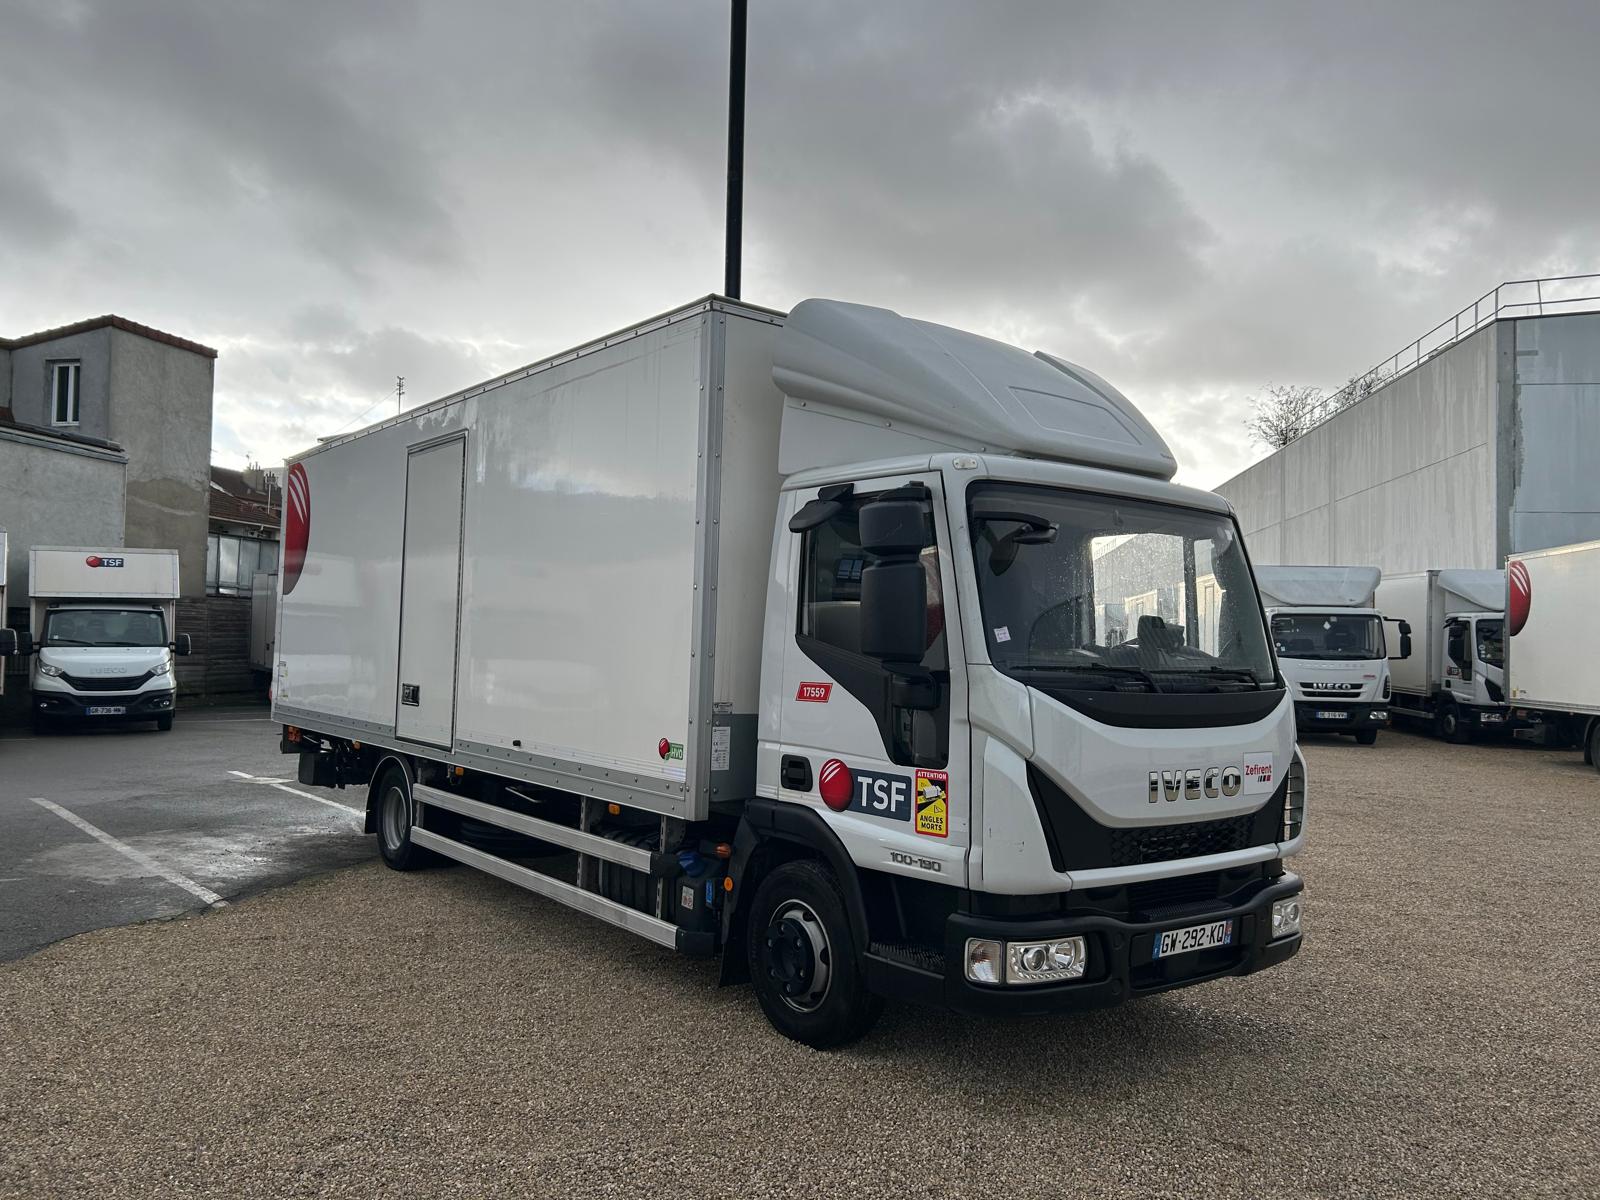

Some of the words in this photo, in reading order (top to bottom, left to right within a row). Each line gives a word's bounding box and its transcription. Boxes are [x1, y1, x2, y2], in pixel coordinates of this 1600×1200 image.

[102, 559, 122, 567] TSF
[803, 687, 825, 698] 17559
[670, 747, 683, 759] HVO
[917, 771, 947, 780] ATTENTION
[1245, 764, 1272, 776] Zefirent
[1148, 765, 1241, 803] IVECO
[857, 776, 906, 812] TSF
[919, 814, 943, 824] ANGLES
[920, 822, 942, 831] MORTS
[890, 852, 942, 873] 100-190
